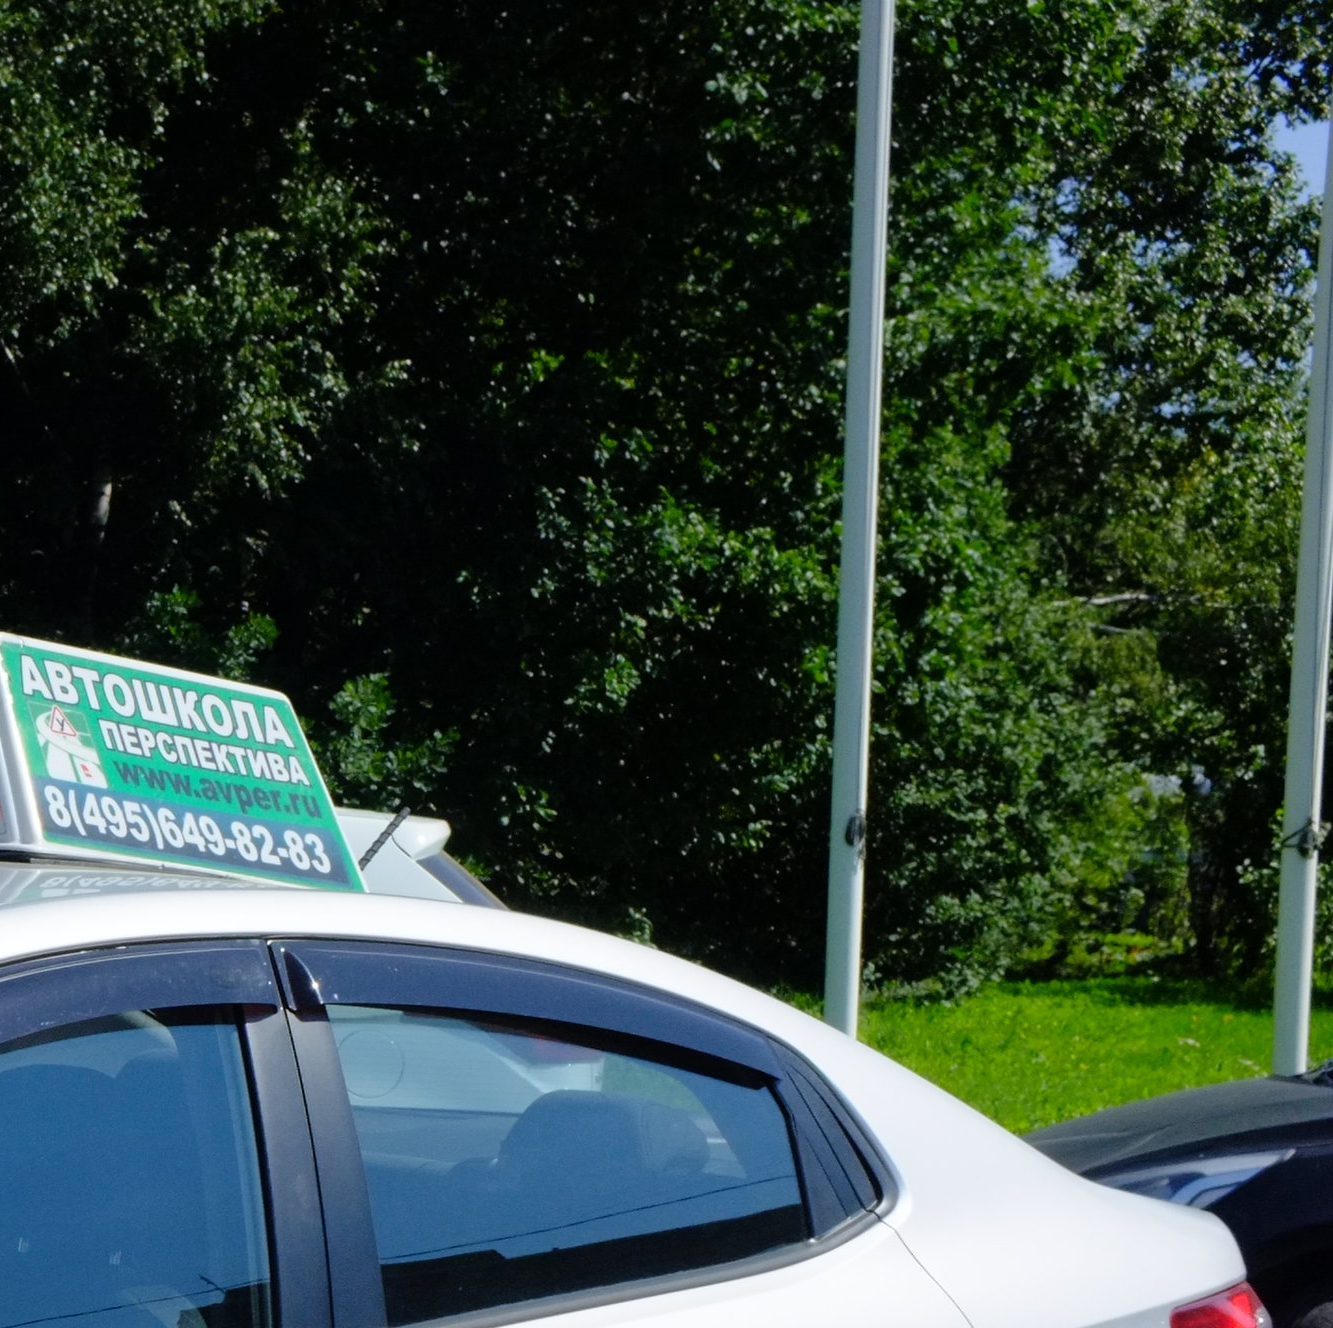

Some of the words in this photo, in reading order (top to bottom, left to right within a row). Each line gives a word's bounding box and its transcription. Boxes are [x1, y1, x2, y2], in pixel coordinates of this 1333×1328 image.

[20, 654, 295, 748] АВТОШКОЛА
[98, 718, 310, 787] ПЕРСПЕКТИВА
[113, 757, 323, 820] www.avper.ru
[44, 785, 331, 874] 8(495)649-82-83
